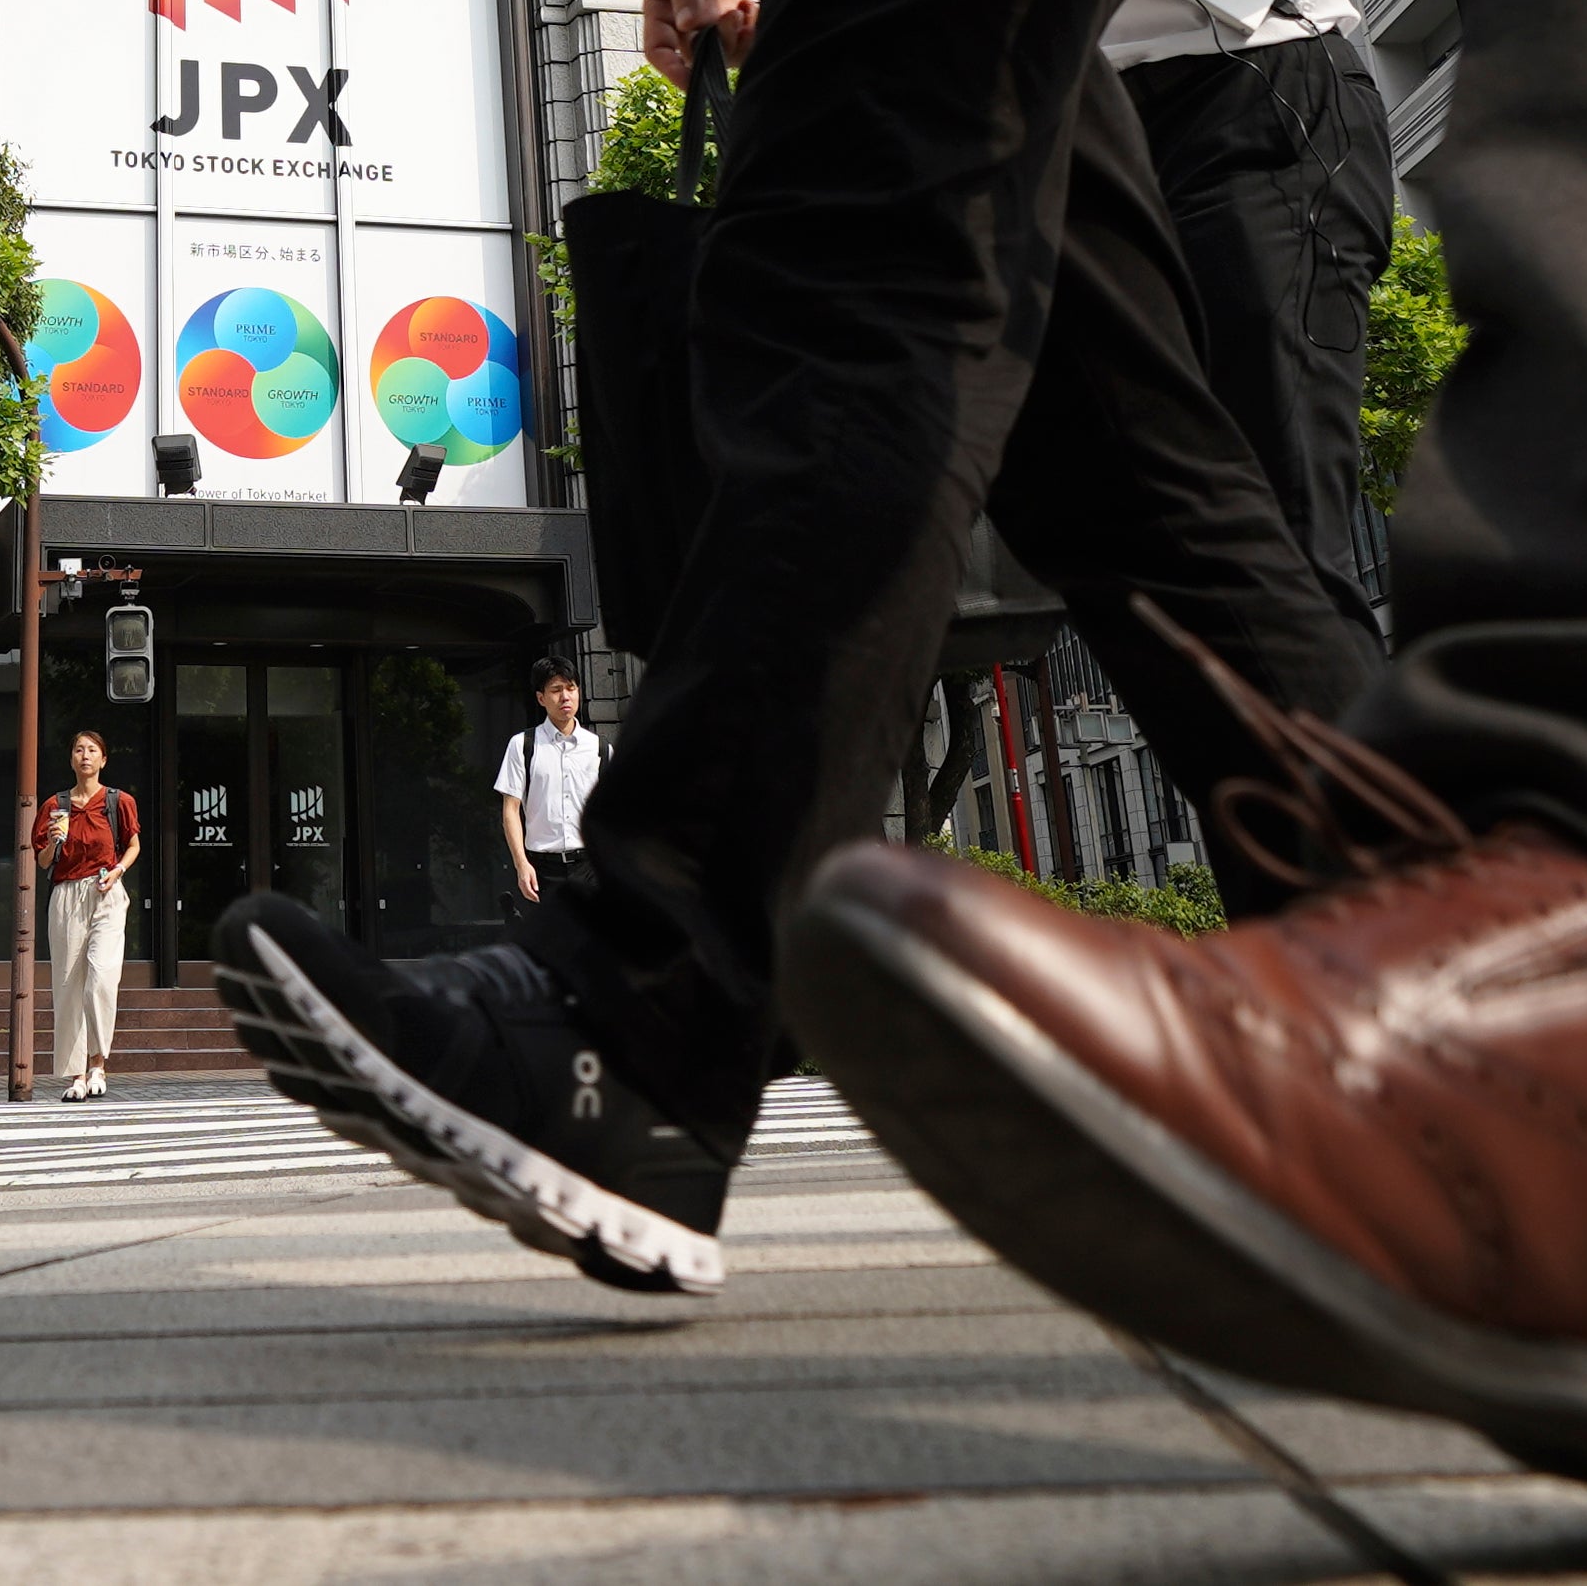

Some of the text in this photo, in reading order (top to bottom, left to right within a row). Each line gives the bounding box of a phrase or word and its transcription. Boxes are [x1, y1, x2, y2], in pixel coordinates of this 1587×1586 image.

[150, 59, 353, 146] JPX
[110, 149, 393, 181] TOKYO STOCK EXCHANGE
[189, 242, 321, 262] 新市場区分、始まる
[44, 327, 69, 335] TOKYO
[236, 324, 276, 336] PRIME
[243, 335, 268, 343] TOKYO
[420, 333, 478, 344] STANDARD
[62, 382, 124, 394] STANDARD
[188, 387, 249, 398] STANDARD
[268, 389, 319, 401] GROWTH
[389, 394, 439, 405] GROWTH
[281, 401, 305, 409] TOKYO
[468, 397, 507, 408] PRIME
[194, 488, 327, 502] ower of Tokyo Market
[194, 826, 227, 841] JPX
[292, 826, 324, 841] JPX
